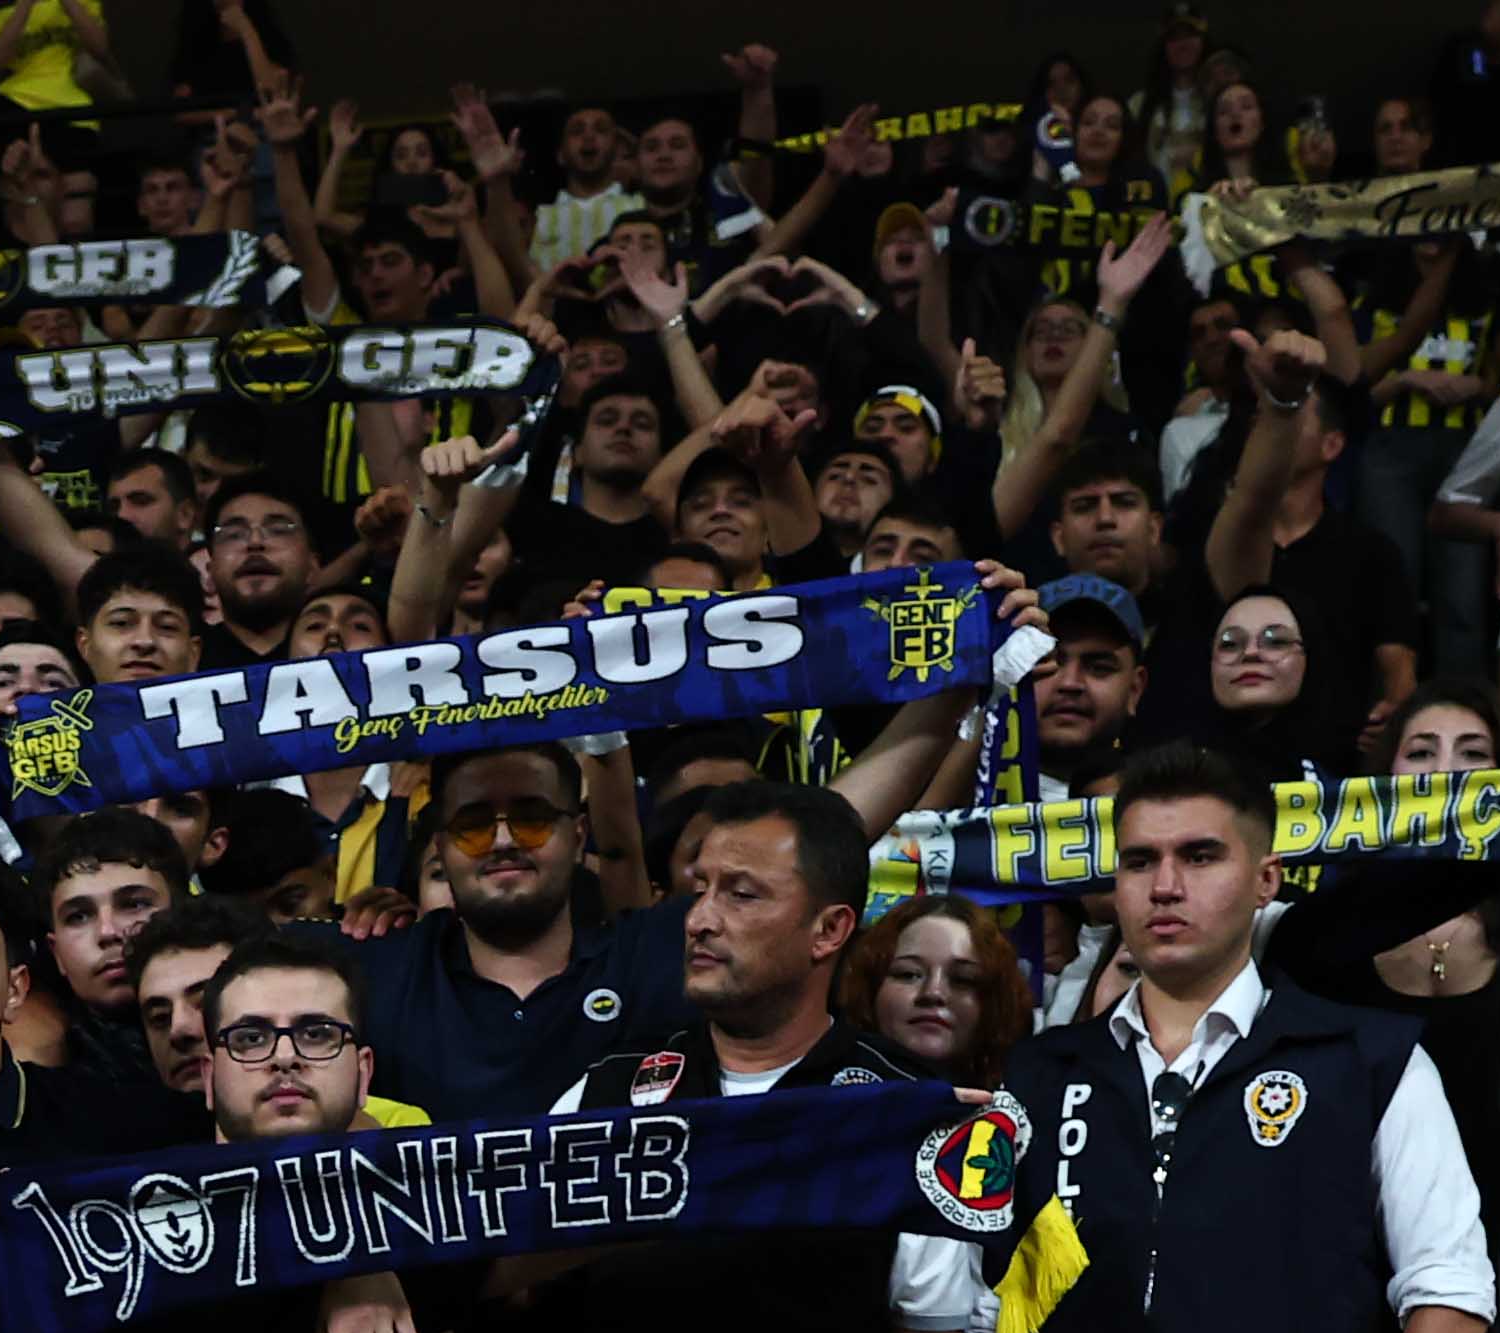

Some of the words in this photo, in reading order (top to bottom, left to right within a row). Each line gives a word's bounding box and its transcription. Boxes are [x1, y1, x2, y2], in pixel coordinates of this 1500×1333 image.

[27, 237, 178, 298] GFB
[15, 336, 221, 413] UNI
[339, 325, 537, 396] GFB
[139, 593, 804, 750] TARSUS
[895, 628, 952, 662] FB
[333, 715, 404, 755] Genç
[12, 754, 78, 781] GFB
[1055, 1083, 1093, 1214] POL
